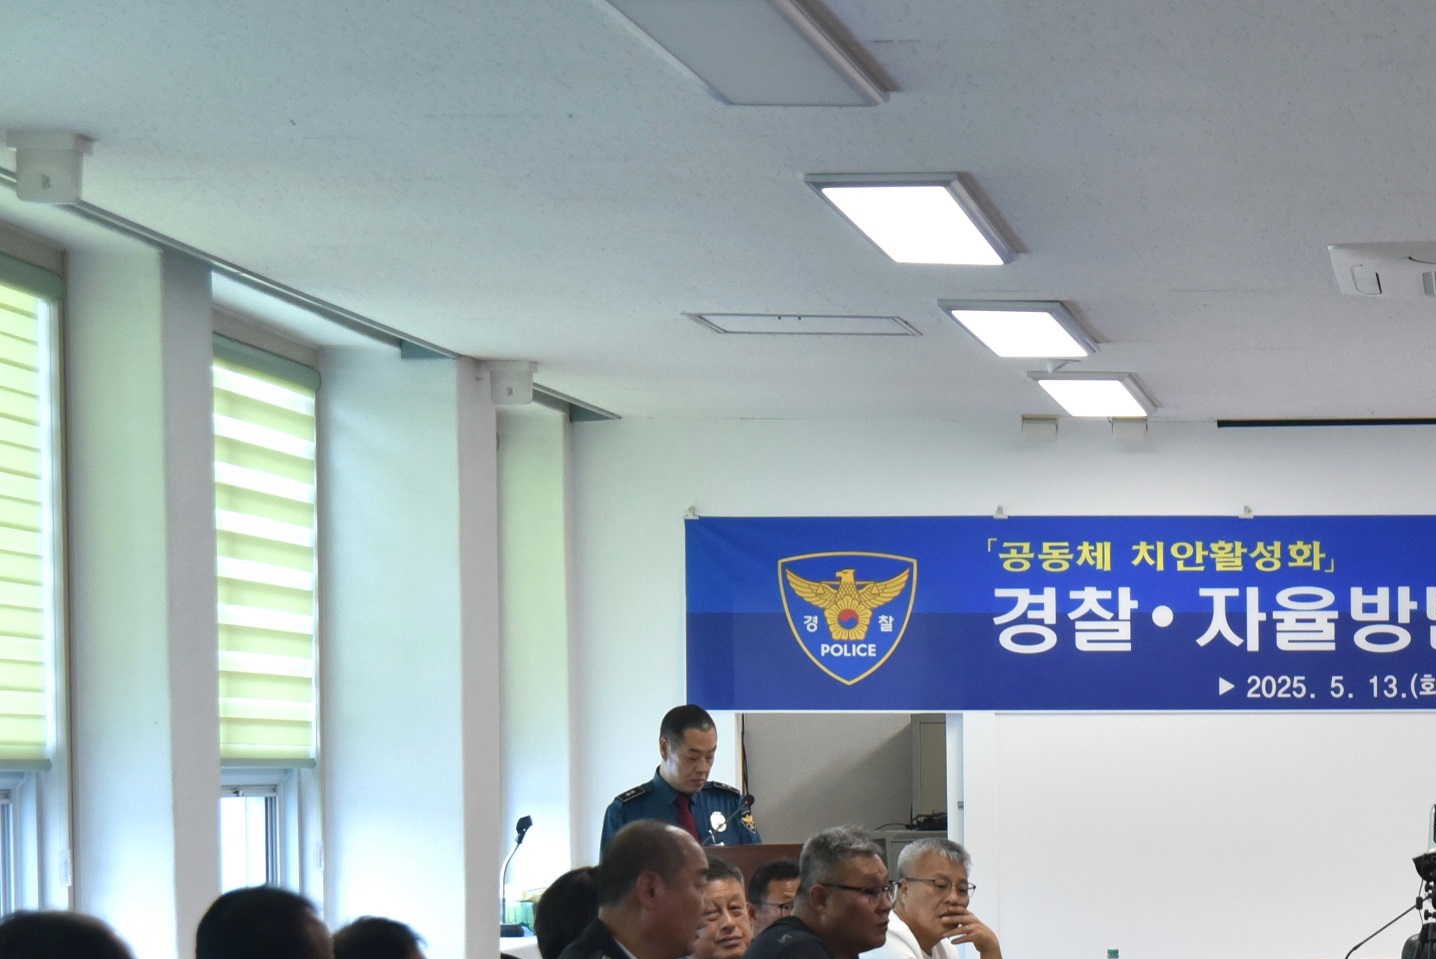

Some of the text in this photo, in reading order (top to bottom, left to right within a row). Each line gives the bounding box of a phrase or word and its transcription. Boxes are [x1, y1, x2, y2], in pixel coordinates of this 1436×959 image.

[803, 614, 895, 633] 경 찰
[820, 643, 877, 657] POLICE
[1246, 675, 1317, 699] 2025.
[1330, 675, 1355, 699] 5.
